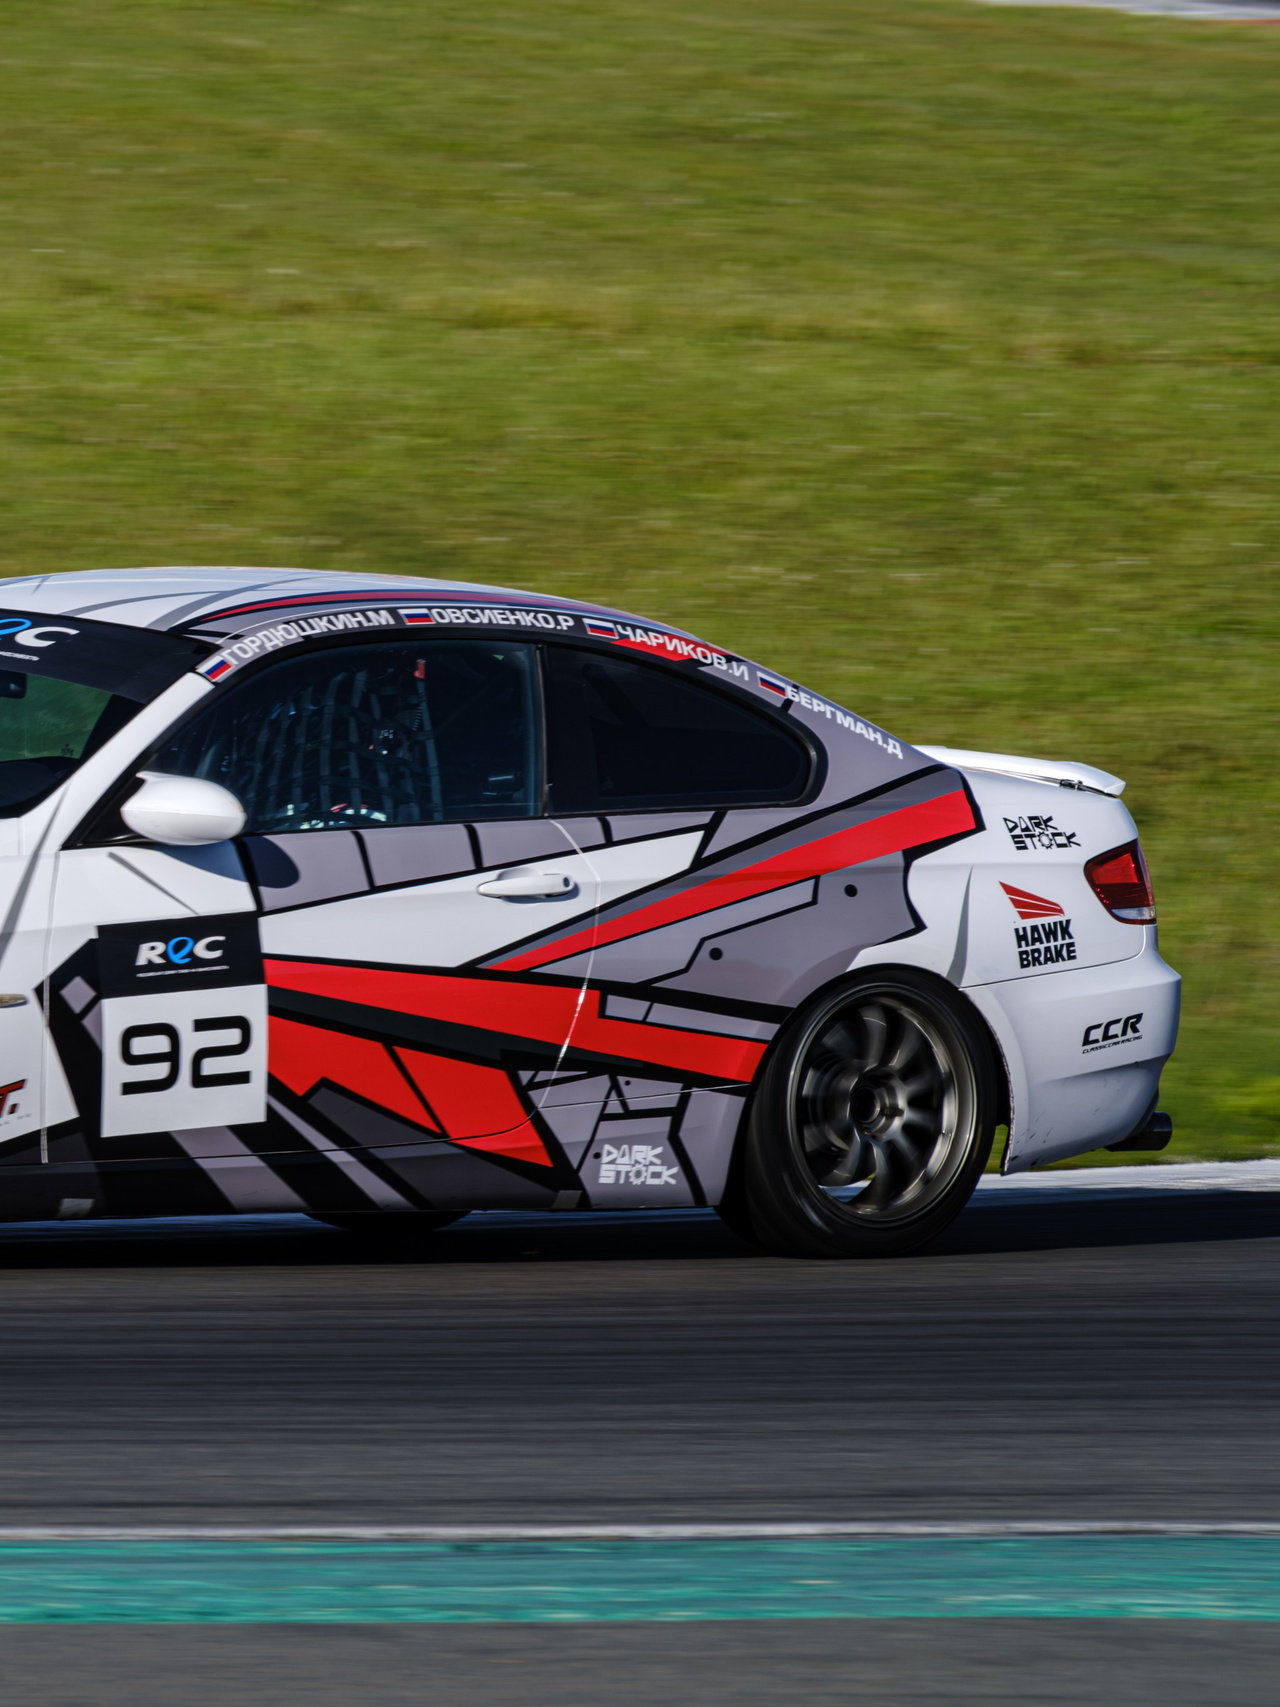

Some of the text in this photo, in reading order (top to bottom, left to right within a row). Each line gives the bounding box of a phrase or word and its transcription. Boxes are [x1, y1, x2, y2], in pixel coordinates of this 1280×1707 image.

[430, 608, 575, 631] ОВСИЕНКО.Р
[222, 609, 396, 665] ГОРДЮШКИН.М
[616, 624, 750, 681] ЧАРИКОВ.И
[786, 685, 904, 759] БЕРГМАН.Д
[1003, 815, 1058, 833] DARK
[1010, 831, 1082, 850] STOCK
[1014, 919, 1074, 948] HAWK
[1018, 941, 1077, 969] BRAKE
[1082, 1012, 1144, 1047] CCR
[120, 1015, 253, 1096] 92
[601, 1143, 663, 1165] DARK
[598, 1163, 679, 1185] STOCK
